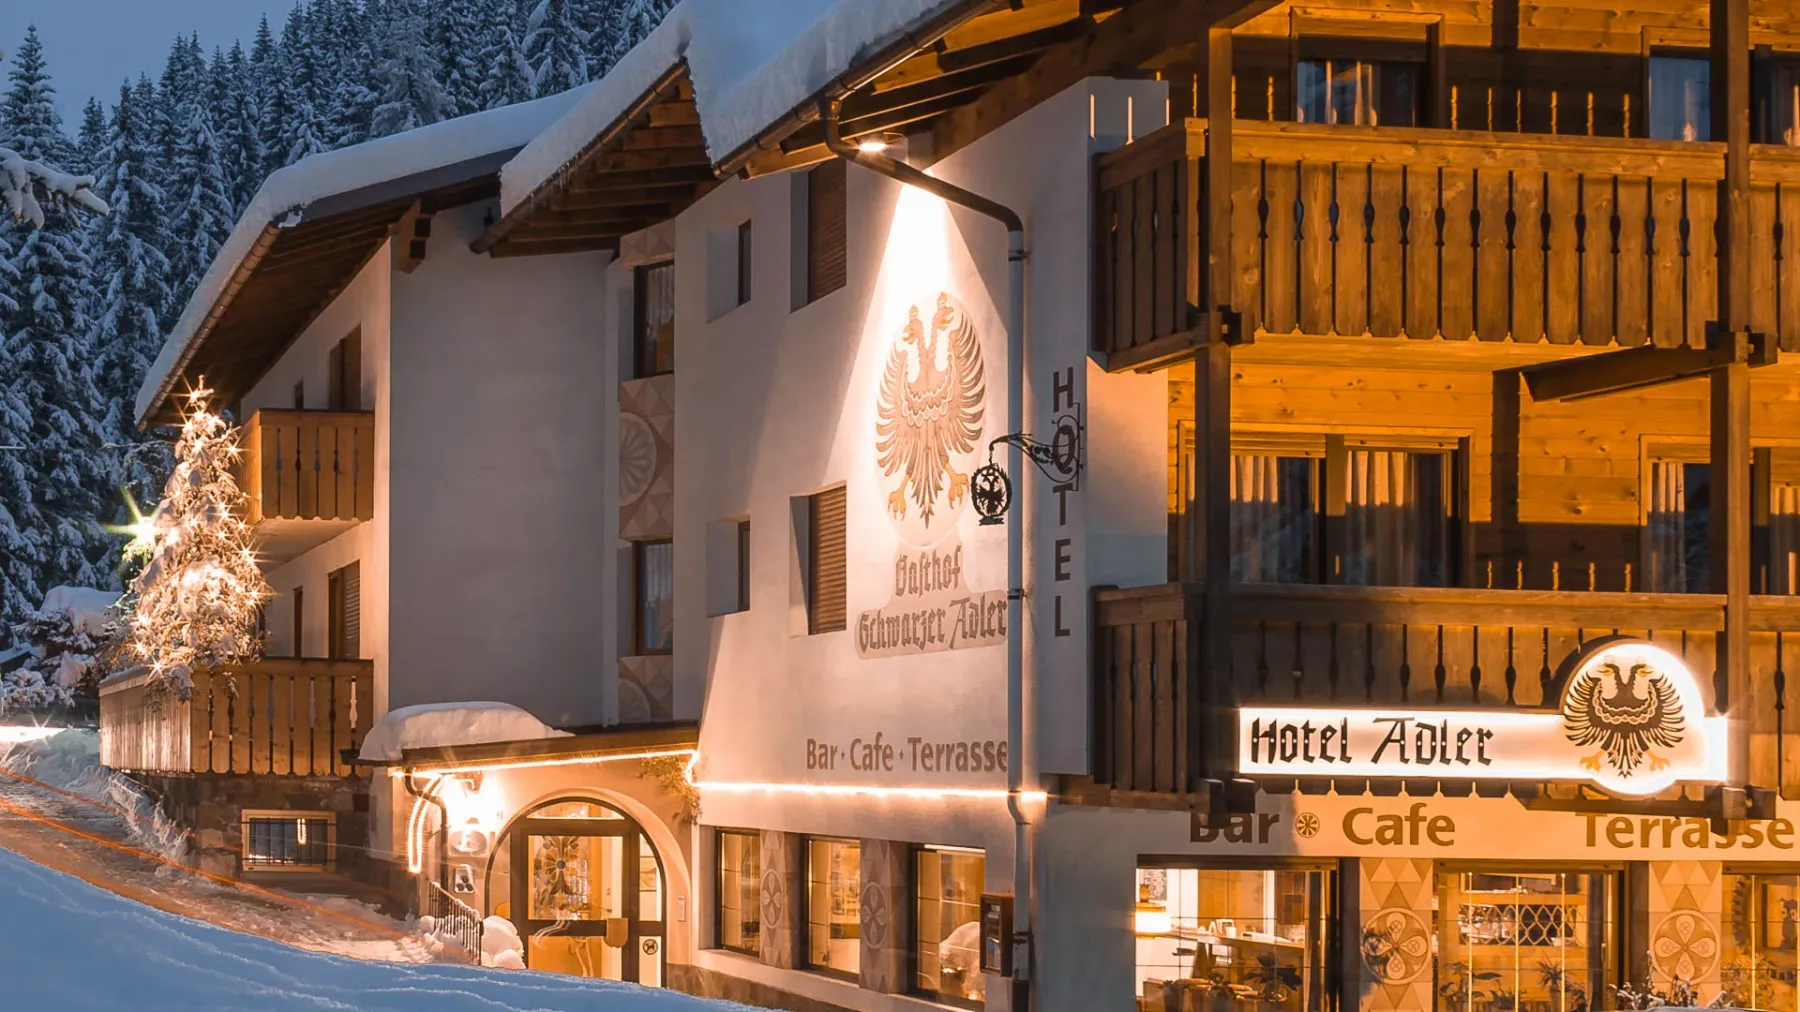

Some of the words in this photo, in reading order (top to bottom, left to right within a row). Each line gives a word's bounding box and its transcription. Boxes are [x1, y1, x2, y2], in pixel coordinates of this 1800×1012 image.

[1052, 367, 1077, 637] HOTEL
[949, 593, 1008, 649] Adler
[806, 739, 838, 770] Bar
[850, 732, 894, 772] Cafe
[907, 737, 1008, 772] Terrasse
[1251, 716, 1352, 764] Hotel
[1371, 717, 1494, 766] Adler
[1342, 802, 1455, 847] Cafe
